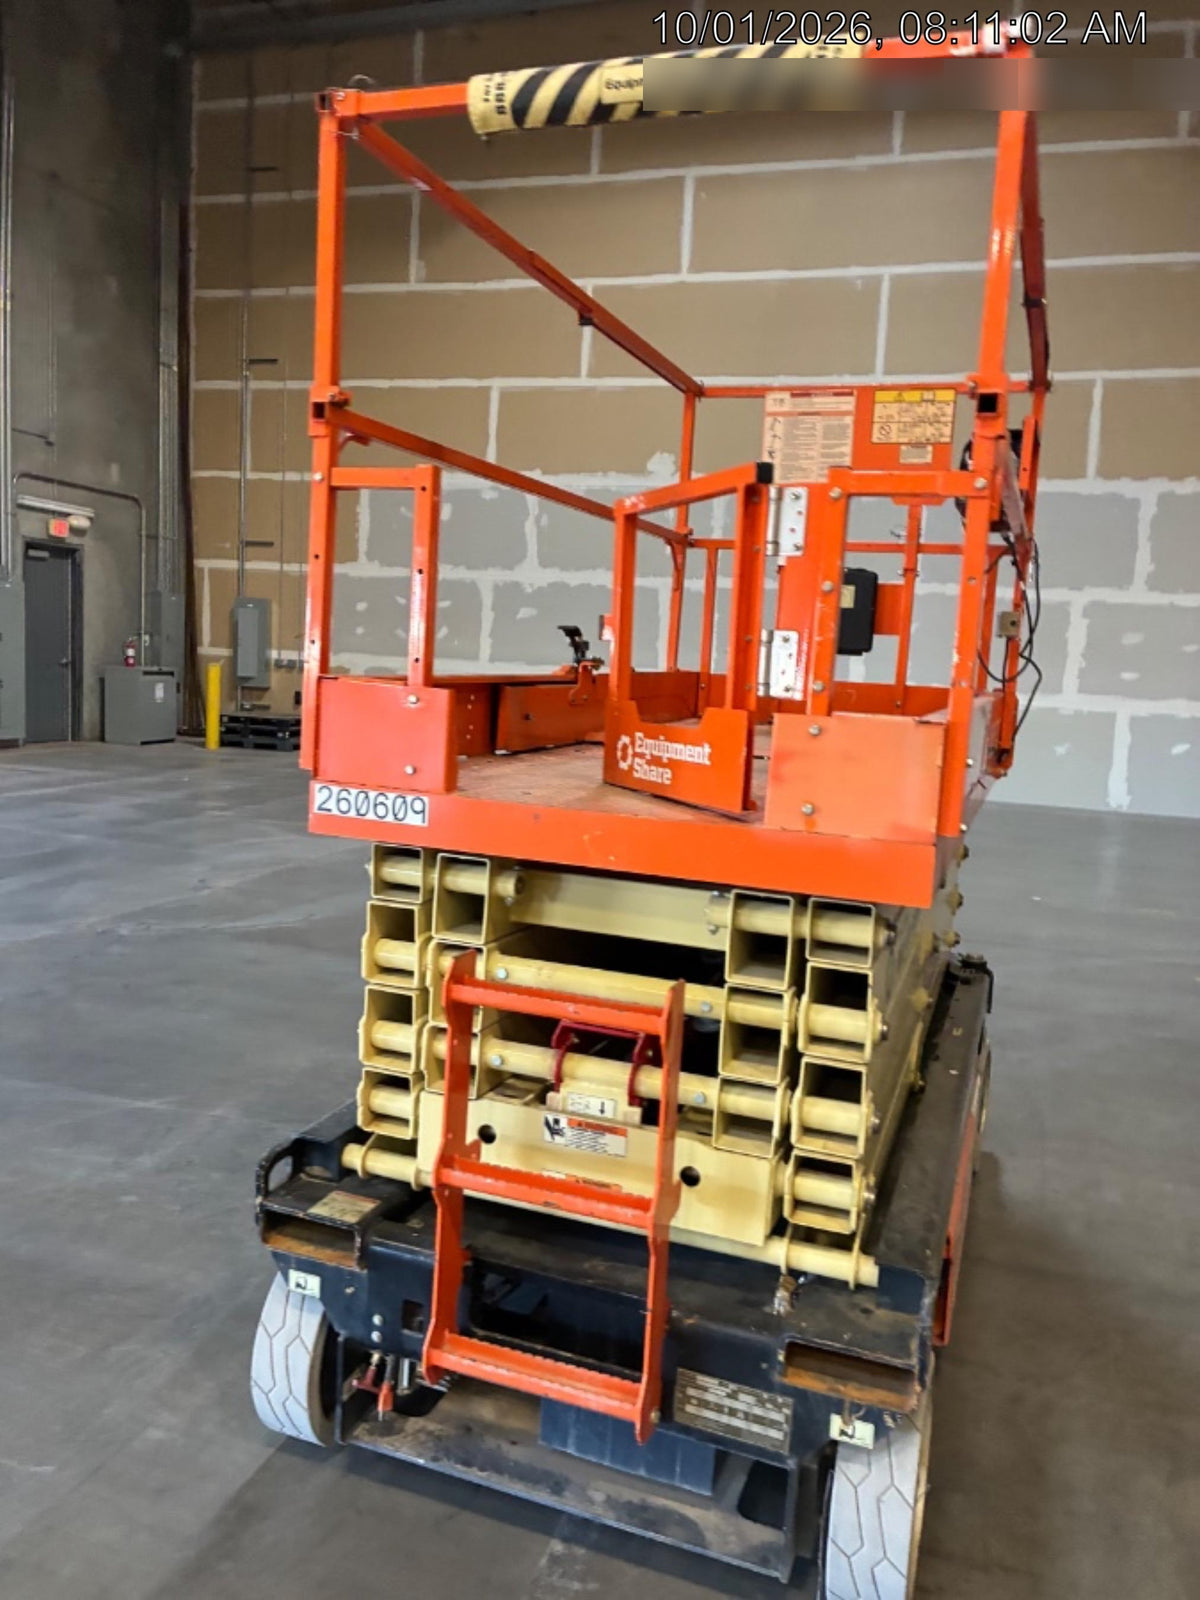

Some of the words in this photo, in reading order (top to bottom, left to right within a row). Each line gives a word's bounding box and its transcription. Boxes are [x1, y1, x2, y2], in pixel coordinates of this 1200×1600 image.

[634, 732, 712, 766] Equipment
[633, 757, 673, 785] Share
[317, 785, 427, 824] 260609
